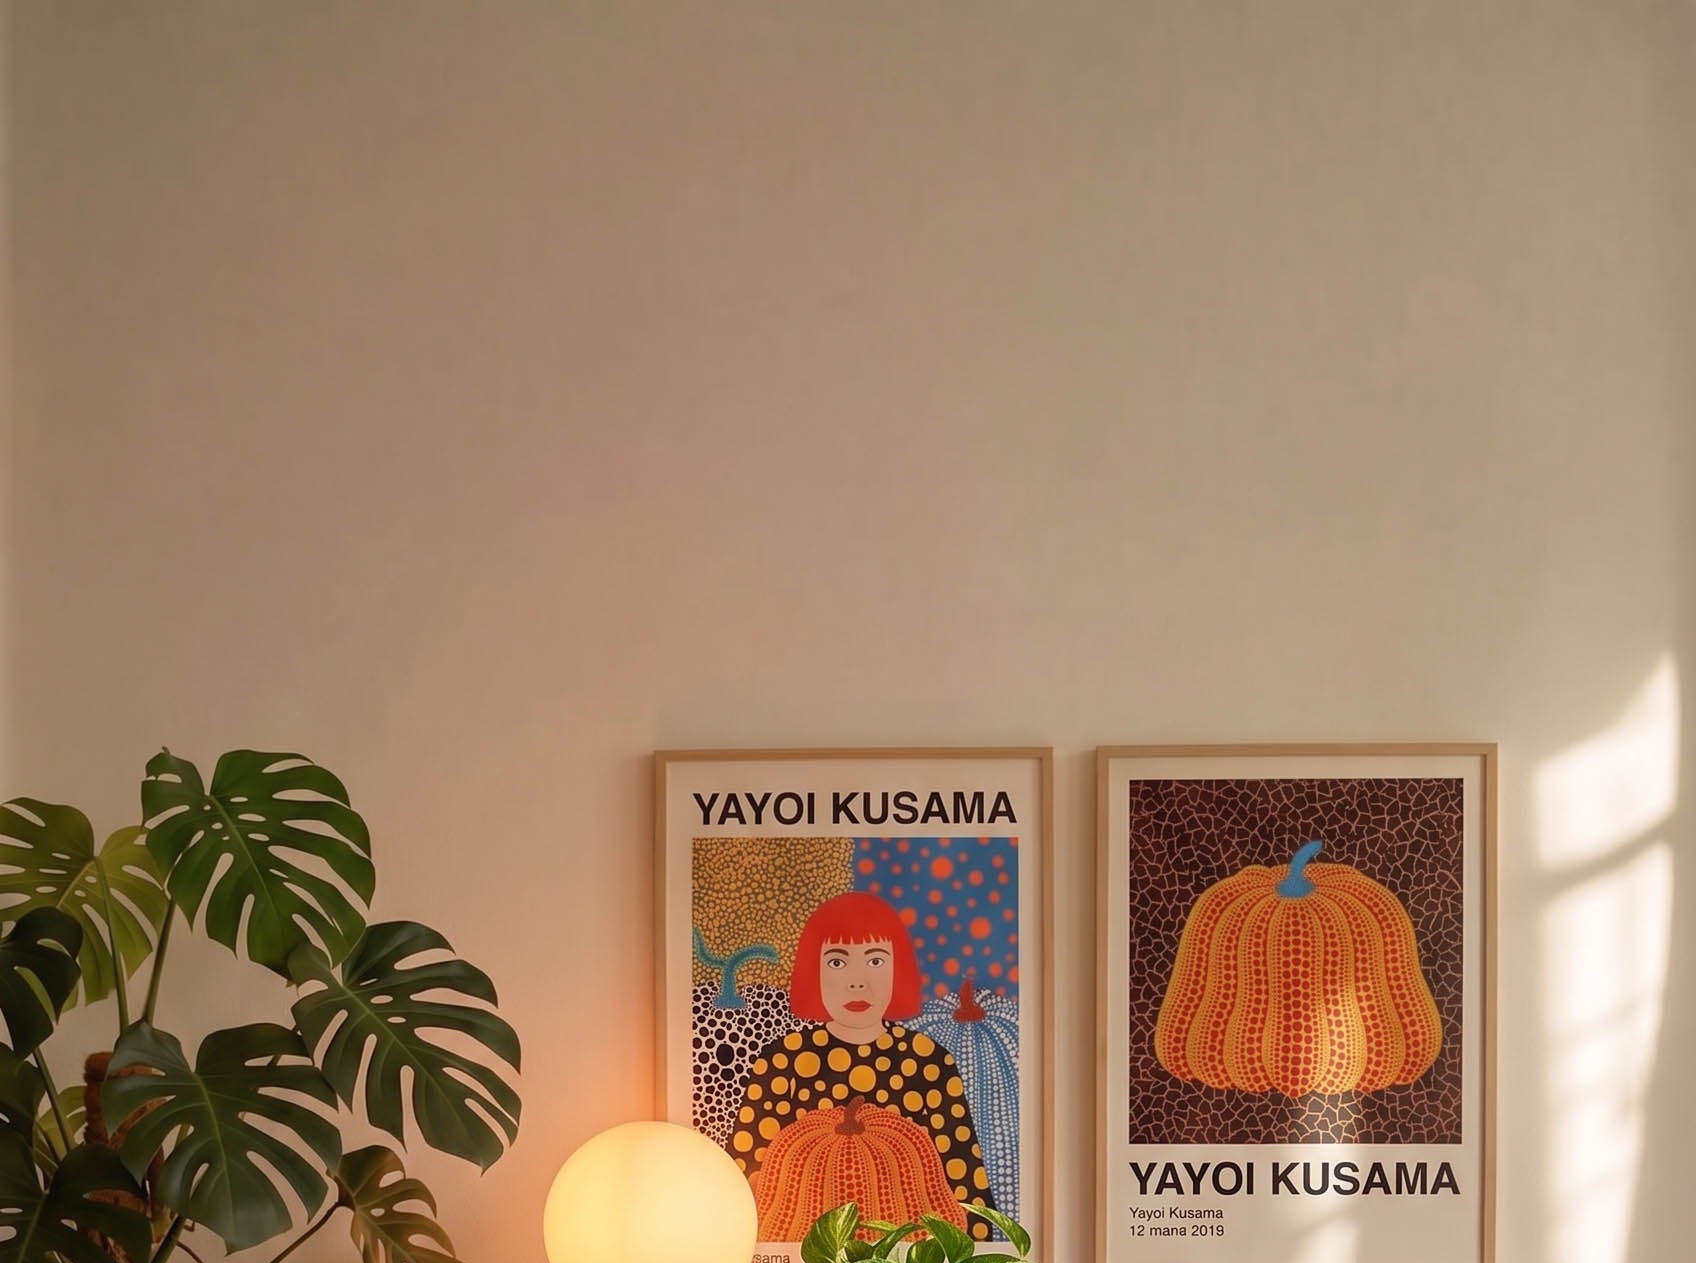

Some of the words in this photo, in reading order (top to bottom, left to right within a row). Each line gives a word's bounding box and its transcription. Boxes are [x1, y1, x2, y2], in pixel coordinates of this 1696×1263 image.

[693, 791, 816, 825] YAYOI
[833, 791, 1018, 825] KUSAMA
[1129, 1162, 1254, 1195] YAYOI
[1272, 1162, 1461, 1195] KUSAMA
[1129, 1206, 1165, 1221] Yayoi
[1169, 1206, 1224, 1219] Kusama
[1129, 1225, 1145, 1237] 12
[1191, 1225, 1225, 1237] 2019
